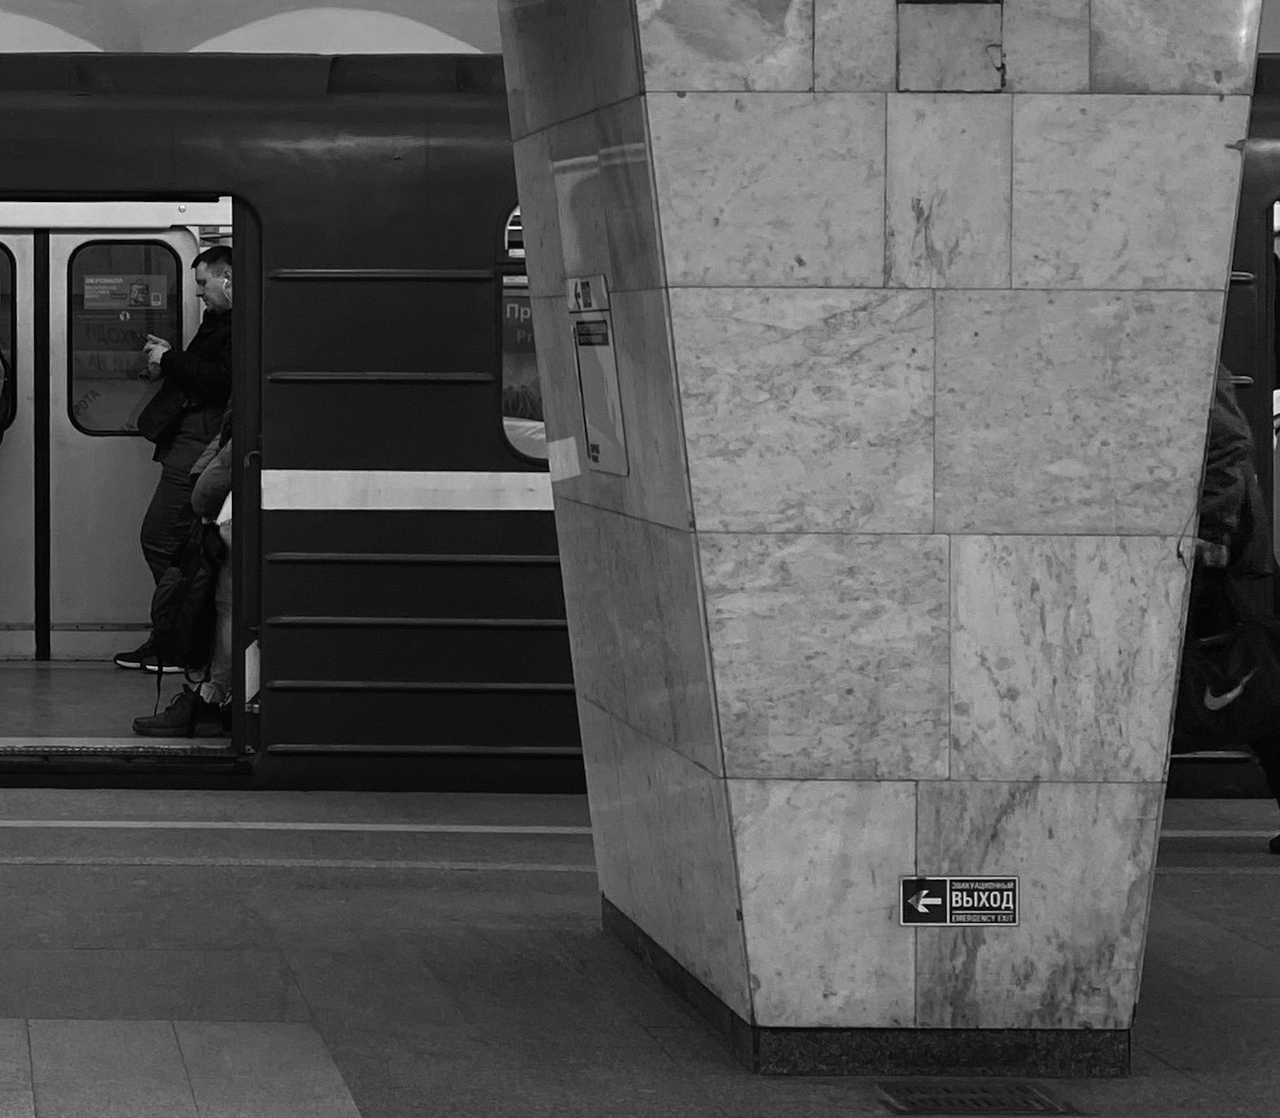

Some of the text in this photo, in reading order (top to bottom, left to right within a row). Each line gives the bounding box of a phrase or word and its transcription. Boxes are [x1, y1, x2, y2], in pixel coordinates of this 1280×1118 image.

[951, 891, 1014, 910] ВЫХОД
[951, 914, 1014, 923] EMERGENCY EXIT
